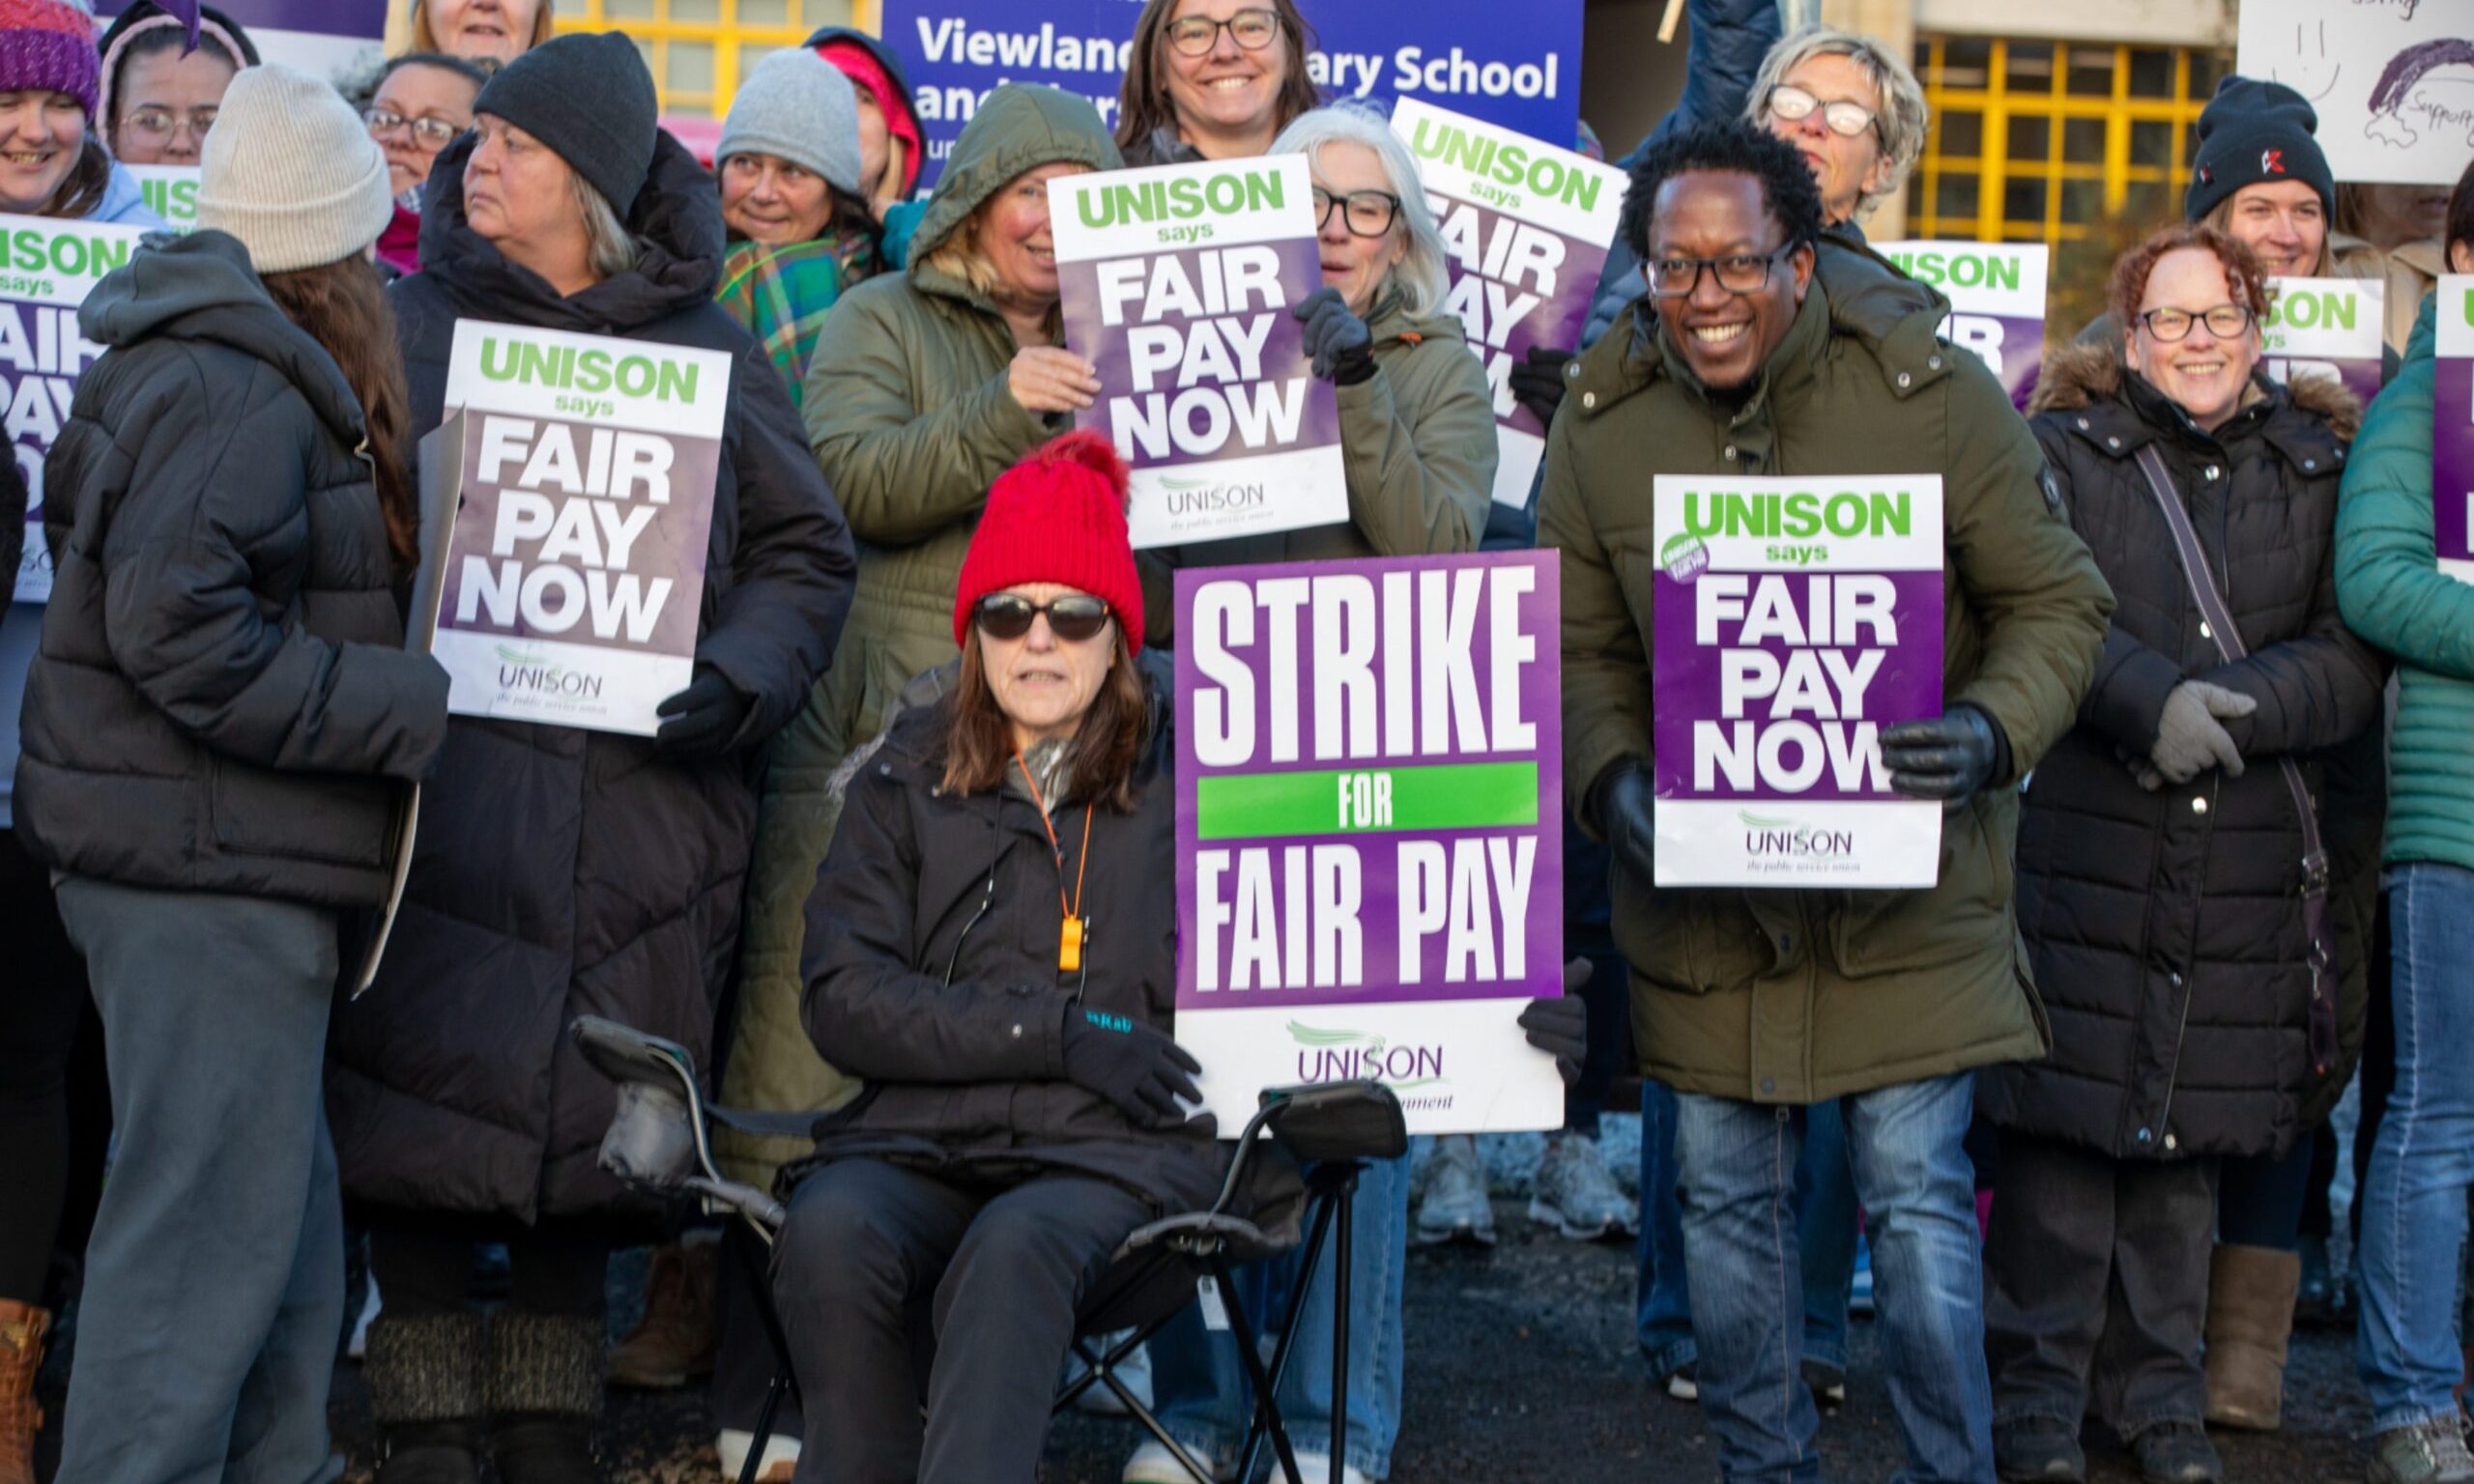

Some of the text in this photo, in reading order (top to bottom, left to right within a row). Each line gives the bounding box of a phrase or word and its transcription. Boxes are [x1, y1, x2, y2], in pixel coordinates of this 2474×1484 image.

[914, 77, 1010, 122] an
[1394, 46, 1558, 99] School
[1411, 117, 1602, 213] UNISON
[1076, 169, 1284, 228] UNISON
[1469, 181, 1523, 210] says
[0, 228, 127, 277] ISON
[1157, 221, 1214, 243] says
[1096, 244, 1286, 327] FAIR
[1888, 252, 2021, 291] ISON
[1444, 272, 1540, 350] AY
[480, 337, 699, 404] UNISON
[1127, 312, 1277, 392] PAY
[554, 395, 615, 417] says
[1109, 377, 1308, 462] NOW
[477, 415, 675, 504] FAIR
[1166, 483, 1265, 516] UNISON
[1683, 492, 1912, 537] UNISON
[492, 489, 658, 570] PAY
[1766, 544, 1828, 565] says
[456, 555, 674, 642] NOW
[1696, 574, 1898, 645] FAIR
[498, 665, 603, 698] UNISON
[1192, 564, 1538, 767] STRIKE
[1720, 648, 1886, 719] PAY
[1693, 720, 1893, 792] NOW
[1338, 772, 1393, 829] FOR
[1746, 830, 1852, 856] UNISON
[1194, 835, 1539, 993] FAIR PAY
[1298, 1044, 1443, 1083] UNISON
[1401, 1093, 1453, 1111] nment
